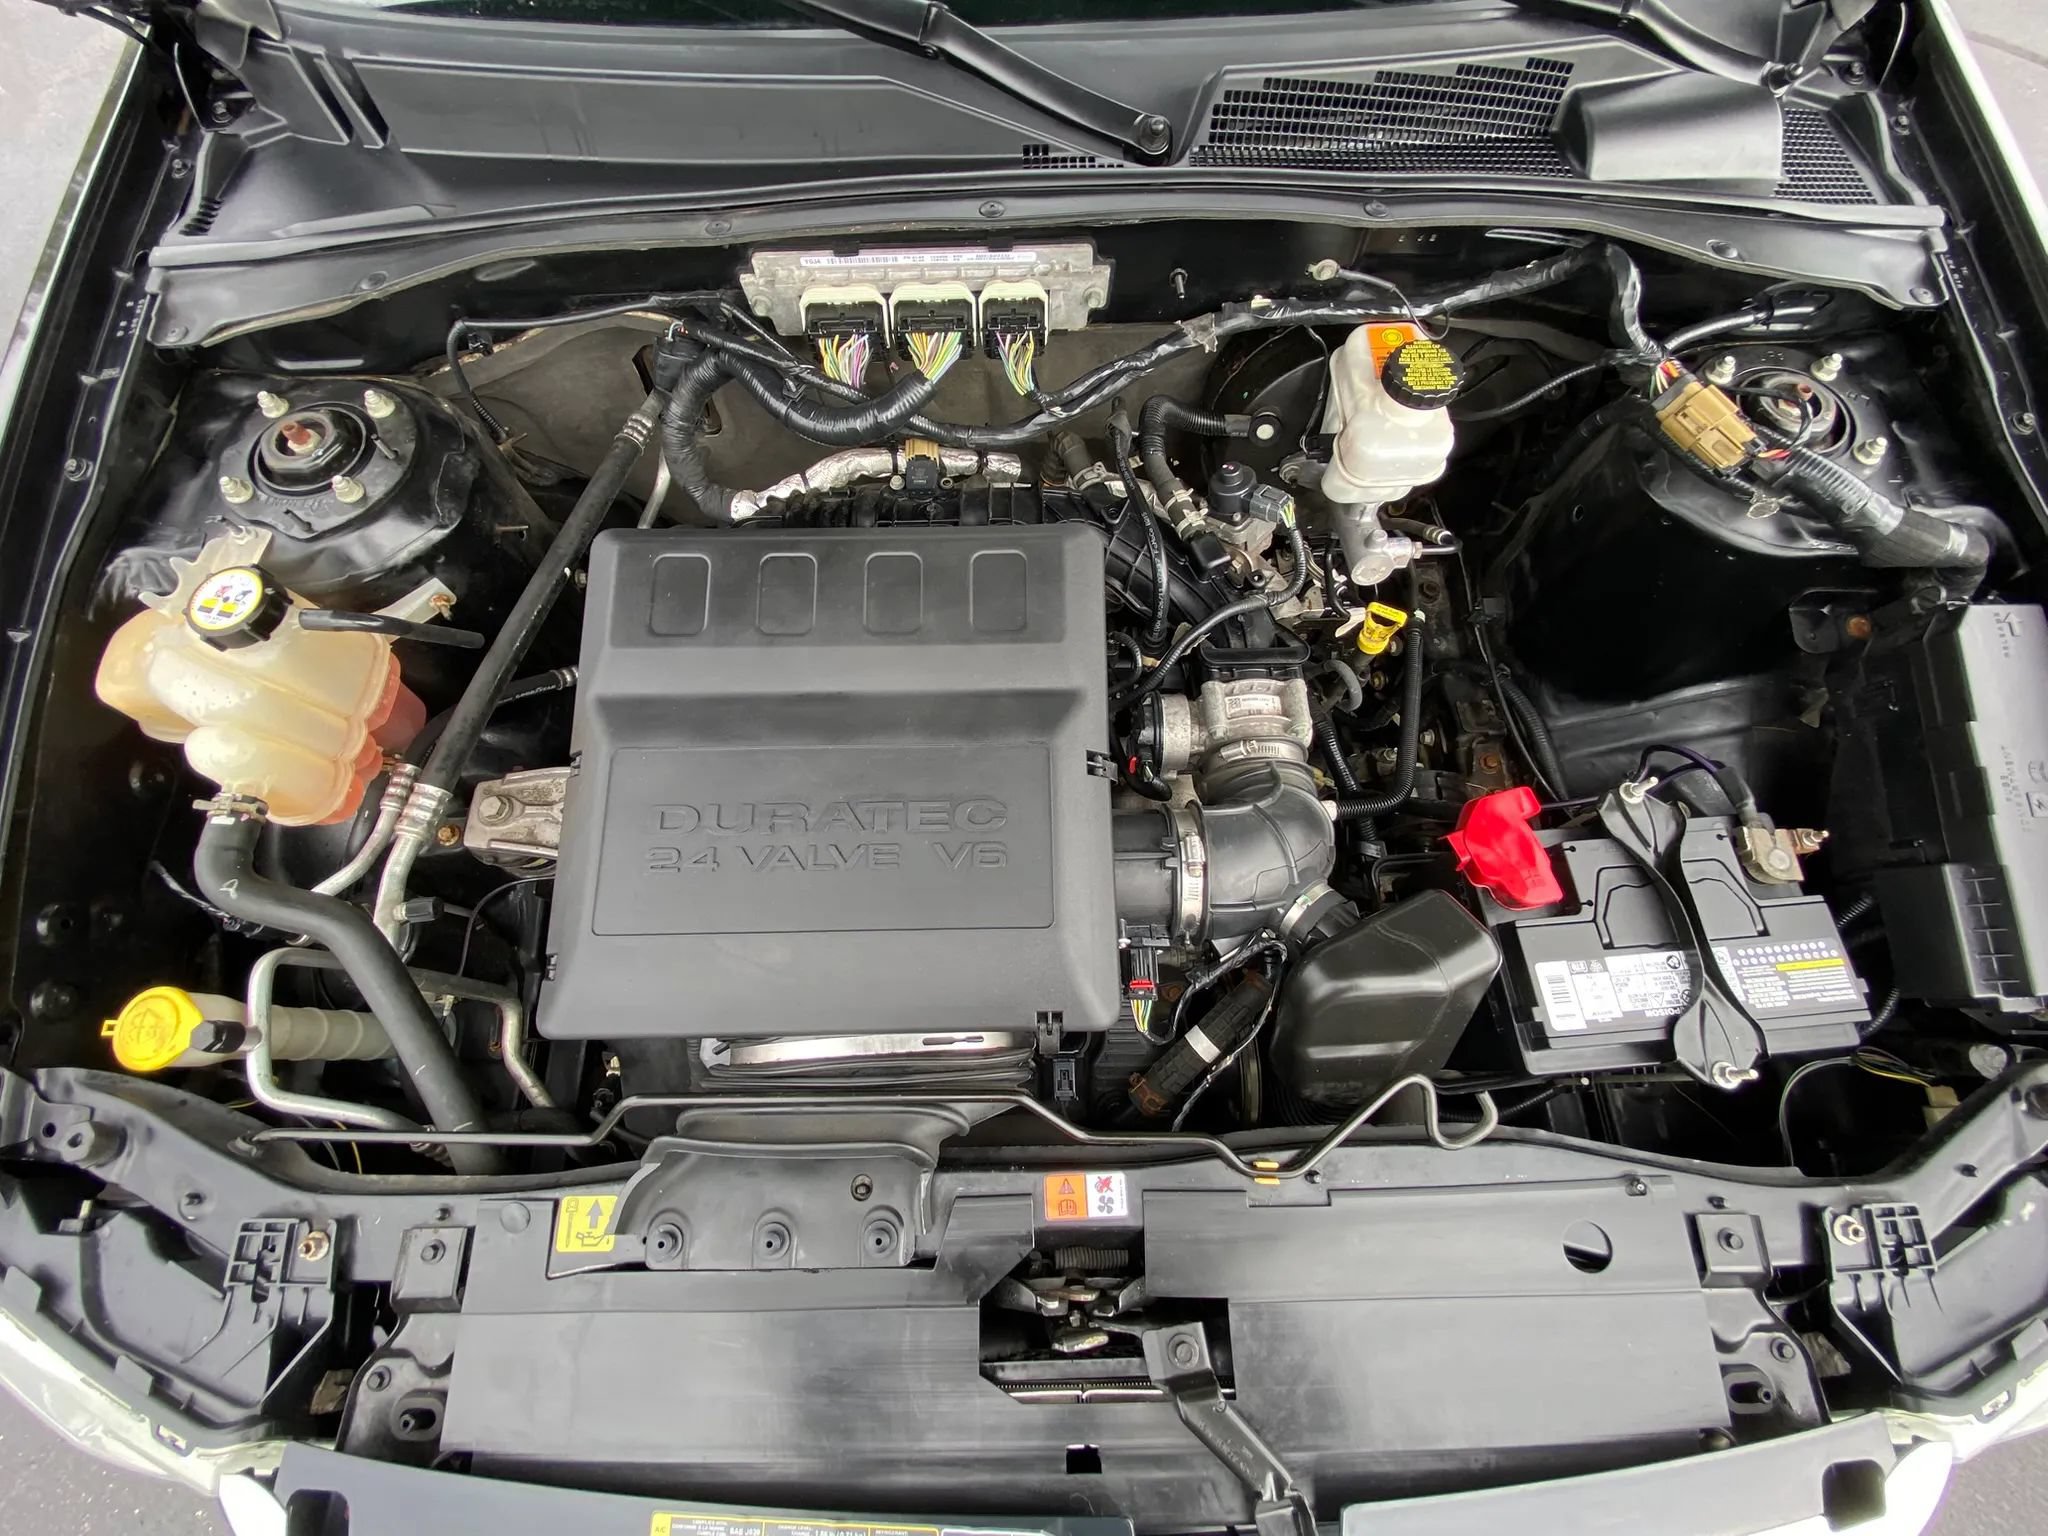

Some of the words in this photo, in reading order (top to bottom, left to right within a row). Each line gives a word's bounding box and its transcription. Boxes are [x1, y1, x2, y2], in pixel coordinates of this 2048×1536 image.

[650, 798, 1009, 836] DURATEC
[647, 845, 719, 873] 24
[735, 841, 901, 872] VALVE
[931, 840, 1008, 870] V6
[654, 1525, 666, 1534] A/C
